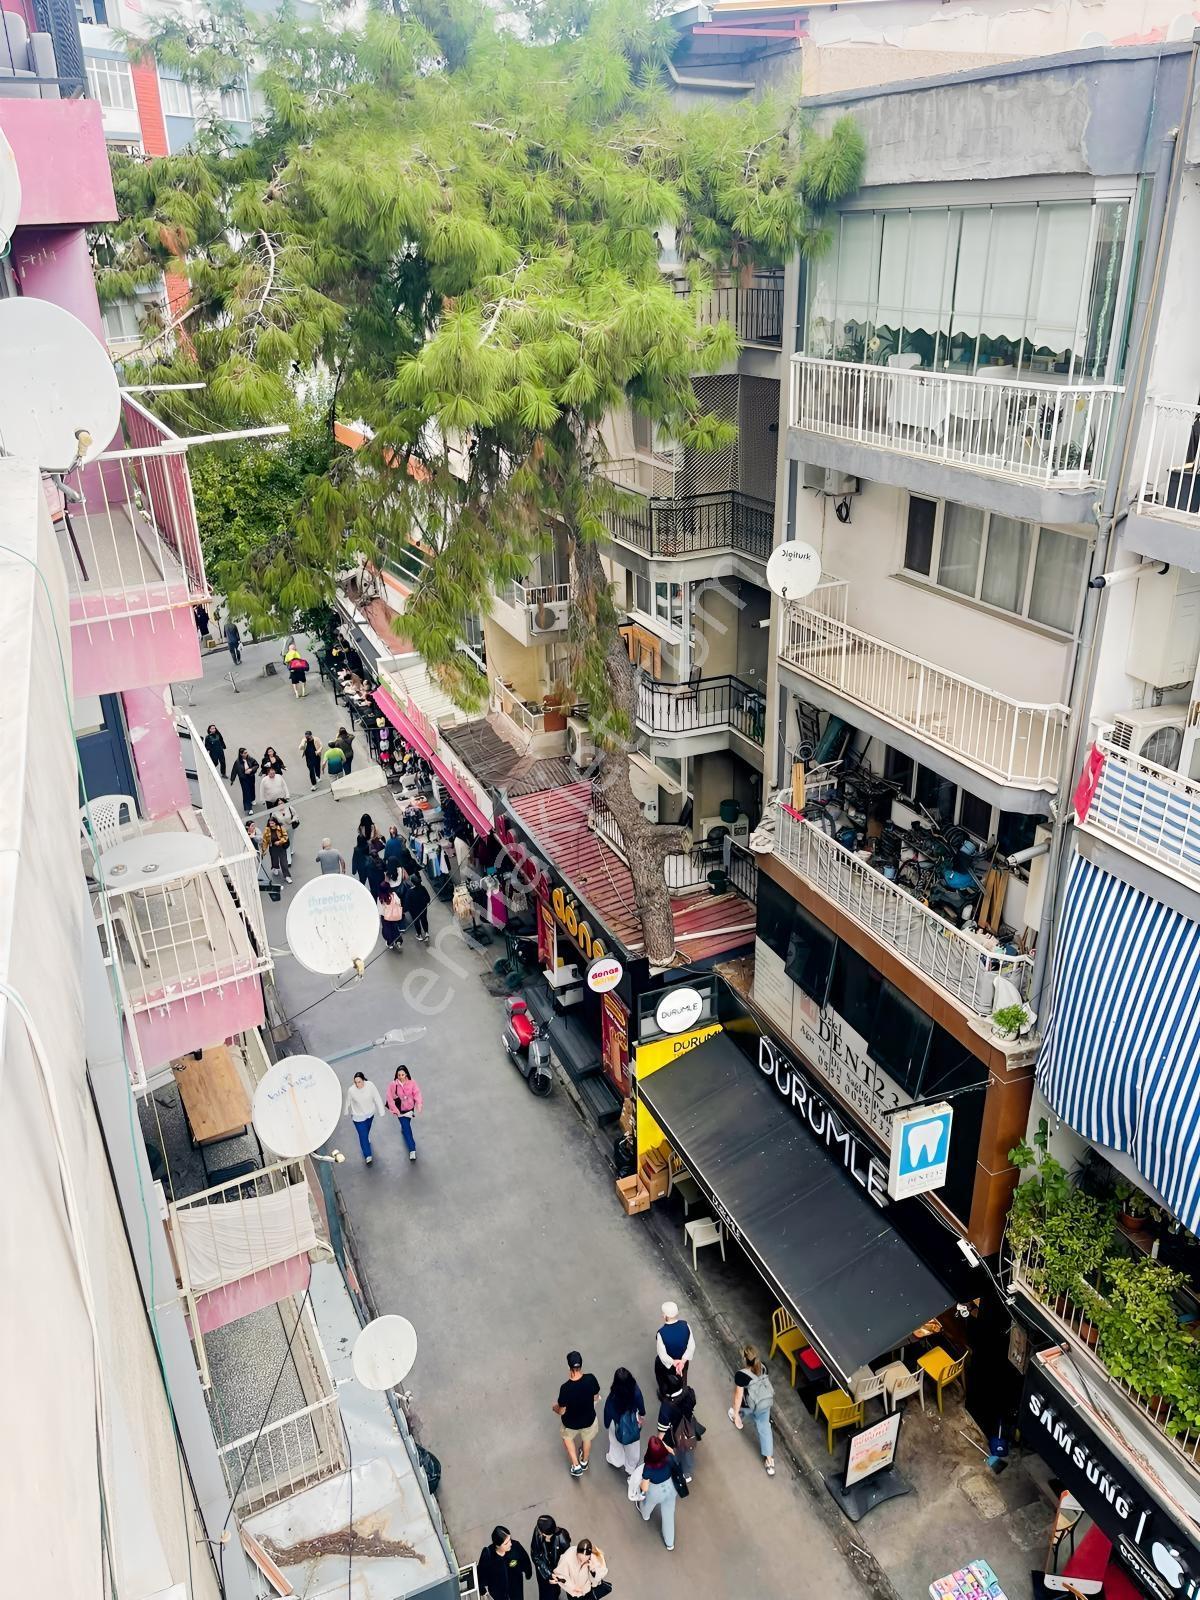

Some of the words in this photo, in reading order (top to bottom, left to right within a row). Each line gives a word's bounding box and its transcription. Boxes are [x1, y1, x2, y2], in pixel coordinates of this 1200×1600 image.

[552, 887, 605, 960] döne
[759, 1036, 888, 1208] DÜRÜMLE
[1029, 1394, 1131, 1520] SAMSUNG
